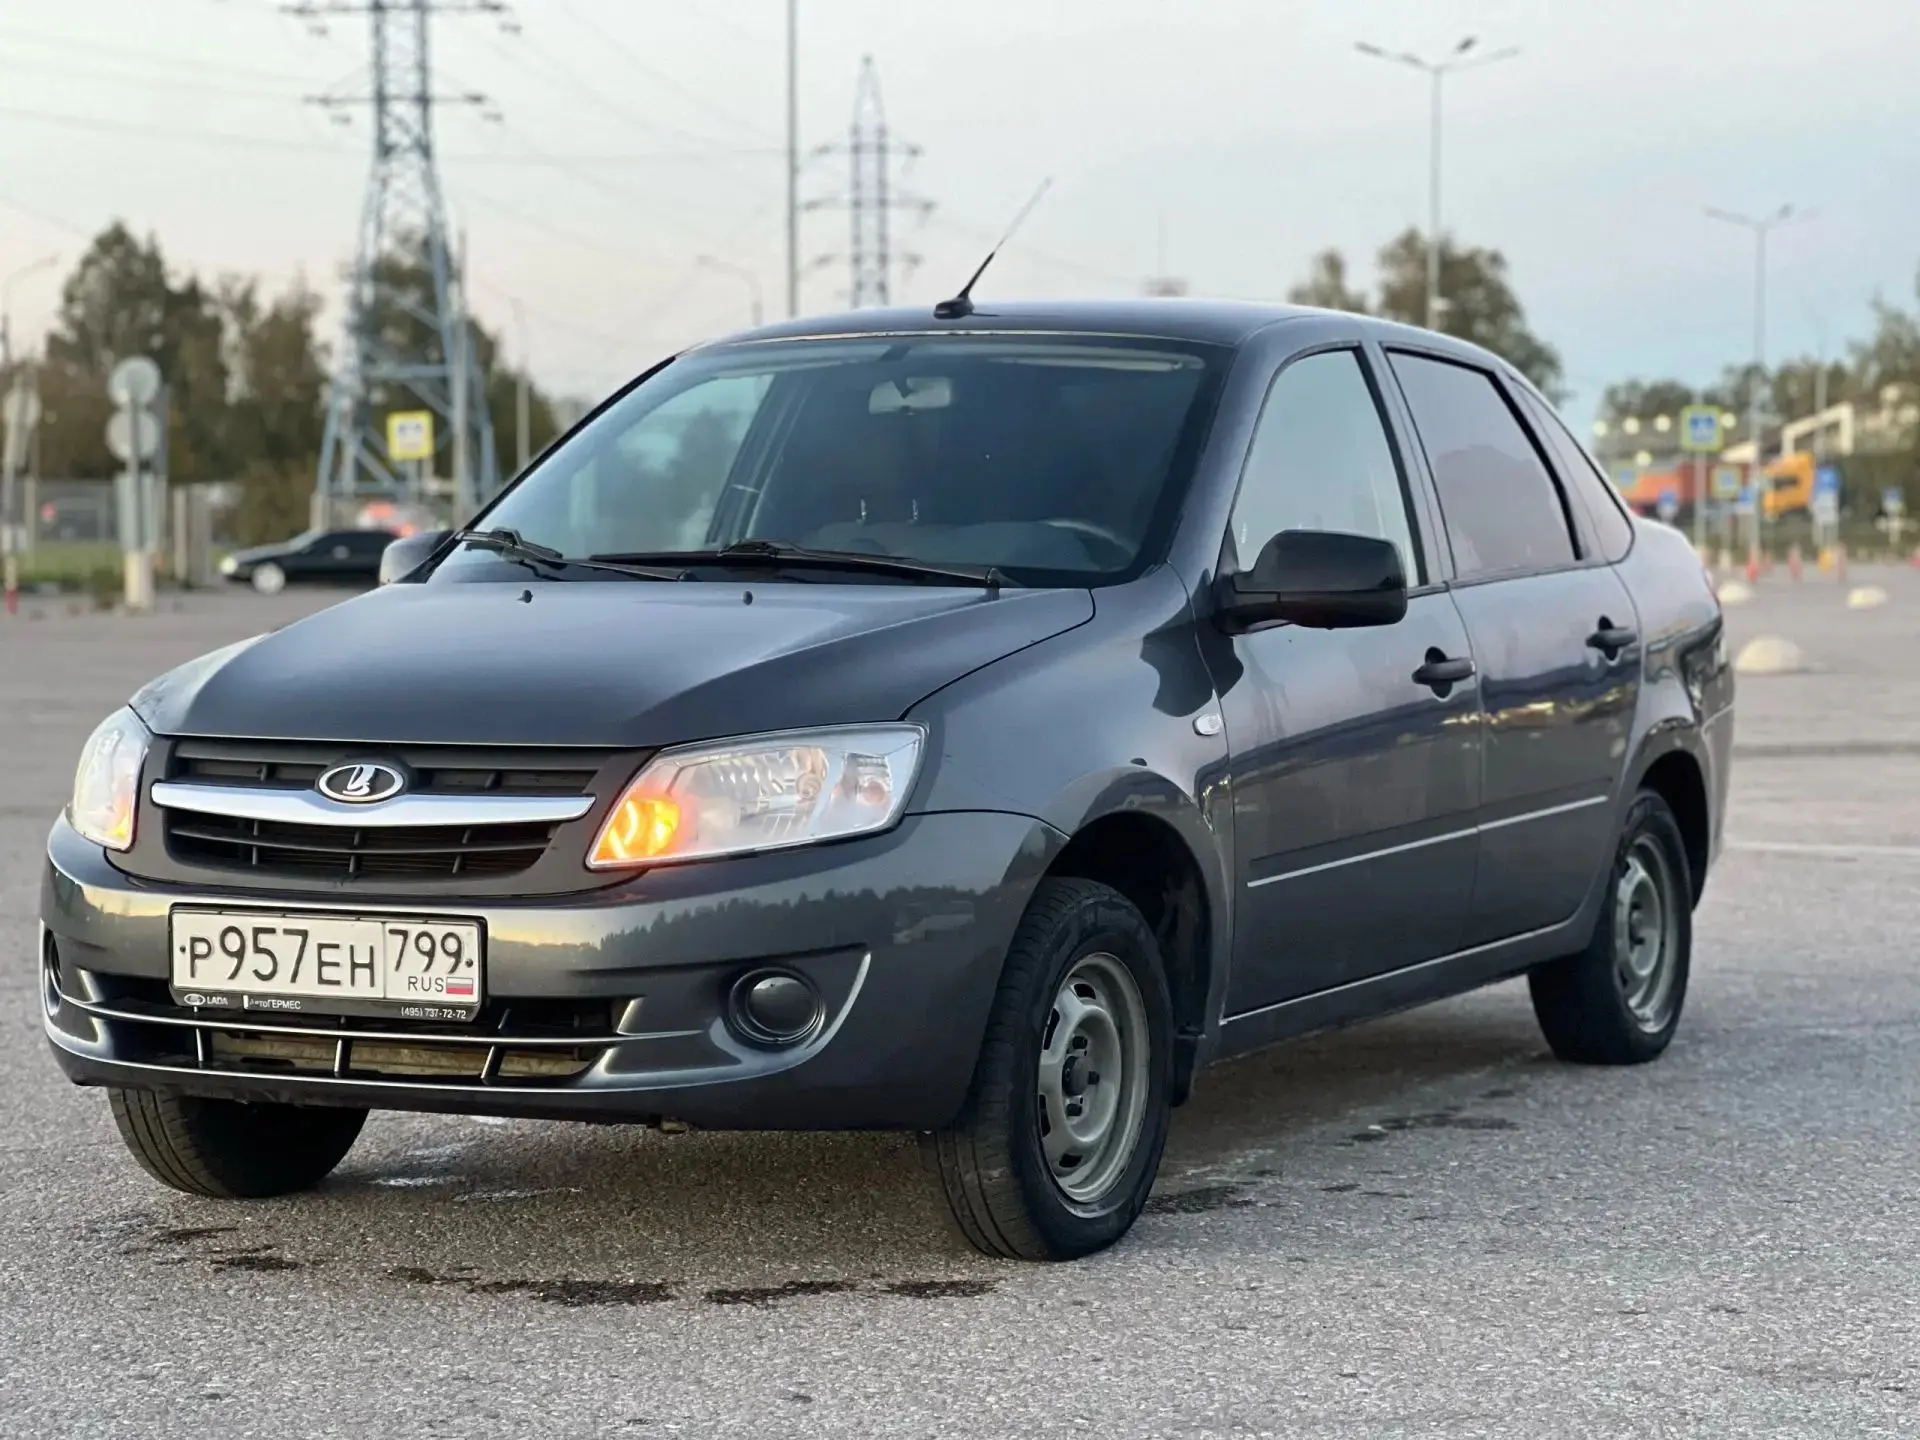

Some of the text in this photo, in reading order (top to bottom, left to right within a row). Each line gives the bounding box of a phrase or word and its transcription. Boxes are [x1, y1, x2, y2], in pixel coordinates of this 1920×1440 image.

[189, 925, 463, 988] Р957ЕН 799
[408, 976, 444, 992] RUS
[206, 995, 228, 1006] LADA
[401, 1006, 467, 1019] (495) 737-72-72
